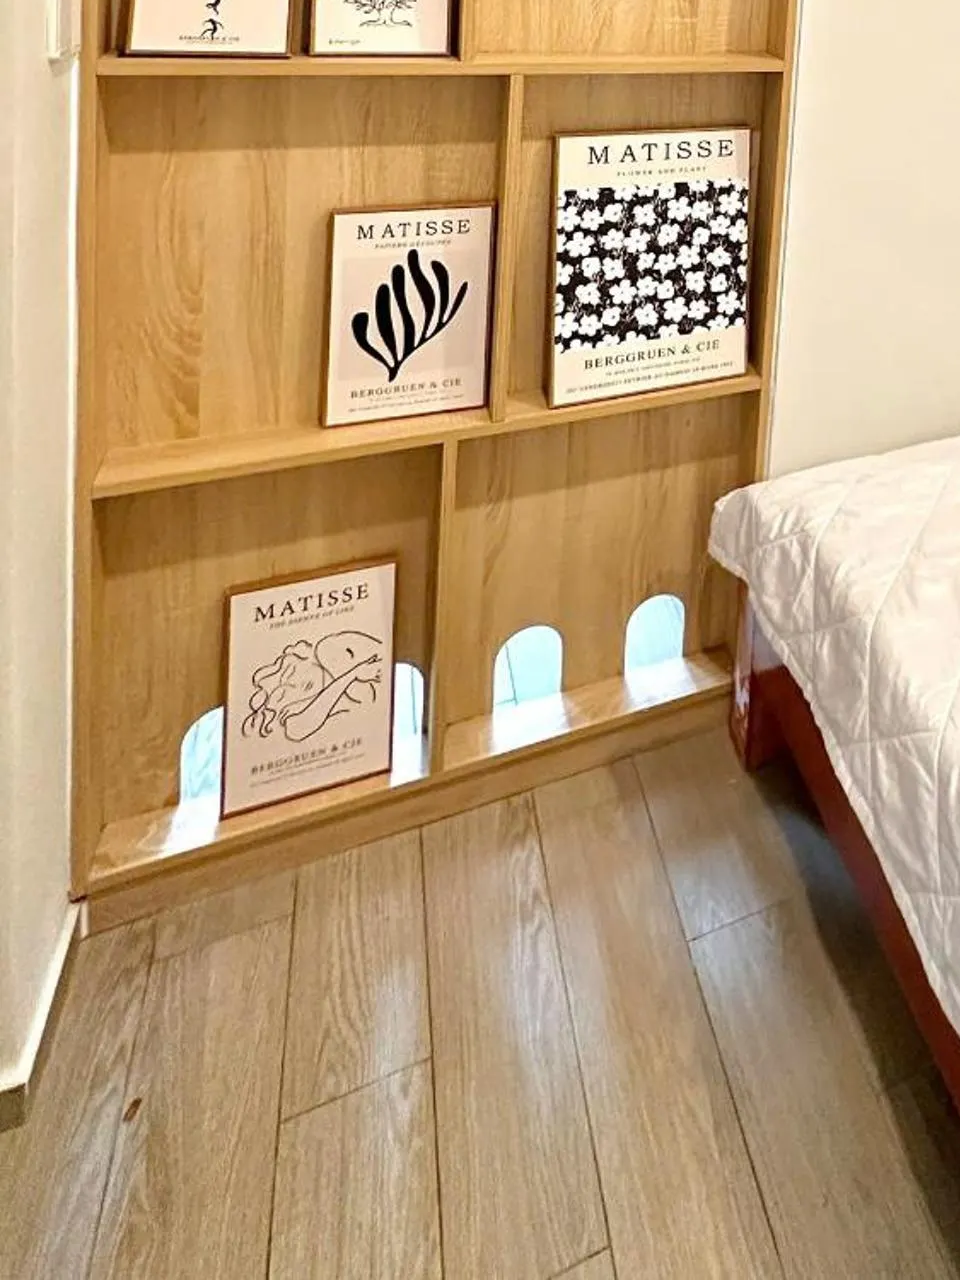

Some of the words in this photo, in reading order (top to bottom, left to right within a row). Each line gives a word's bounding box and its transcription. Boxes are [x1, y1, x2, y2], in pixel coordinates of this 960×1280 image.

[587, 139, 734, 165] MATISSE
[357, 219, 471, 240] MATISSE
[584, 347, 677, 370] BERGGRUEN
[681, 344, 691, 354] &
[696, 339, 721, 353] CIE
[350, 383, 425, 399] BERGGRUEN
[430, 381, 437, 389] &
[442, 377, 462, 388] CIE
[254, 582, 370, 623] MATISSE
